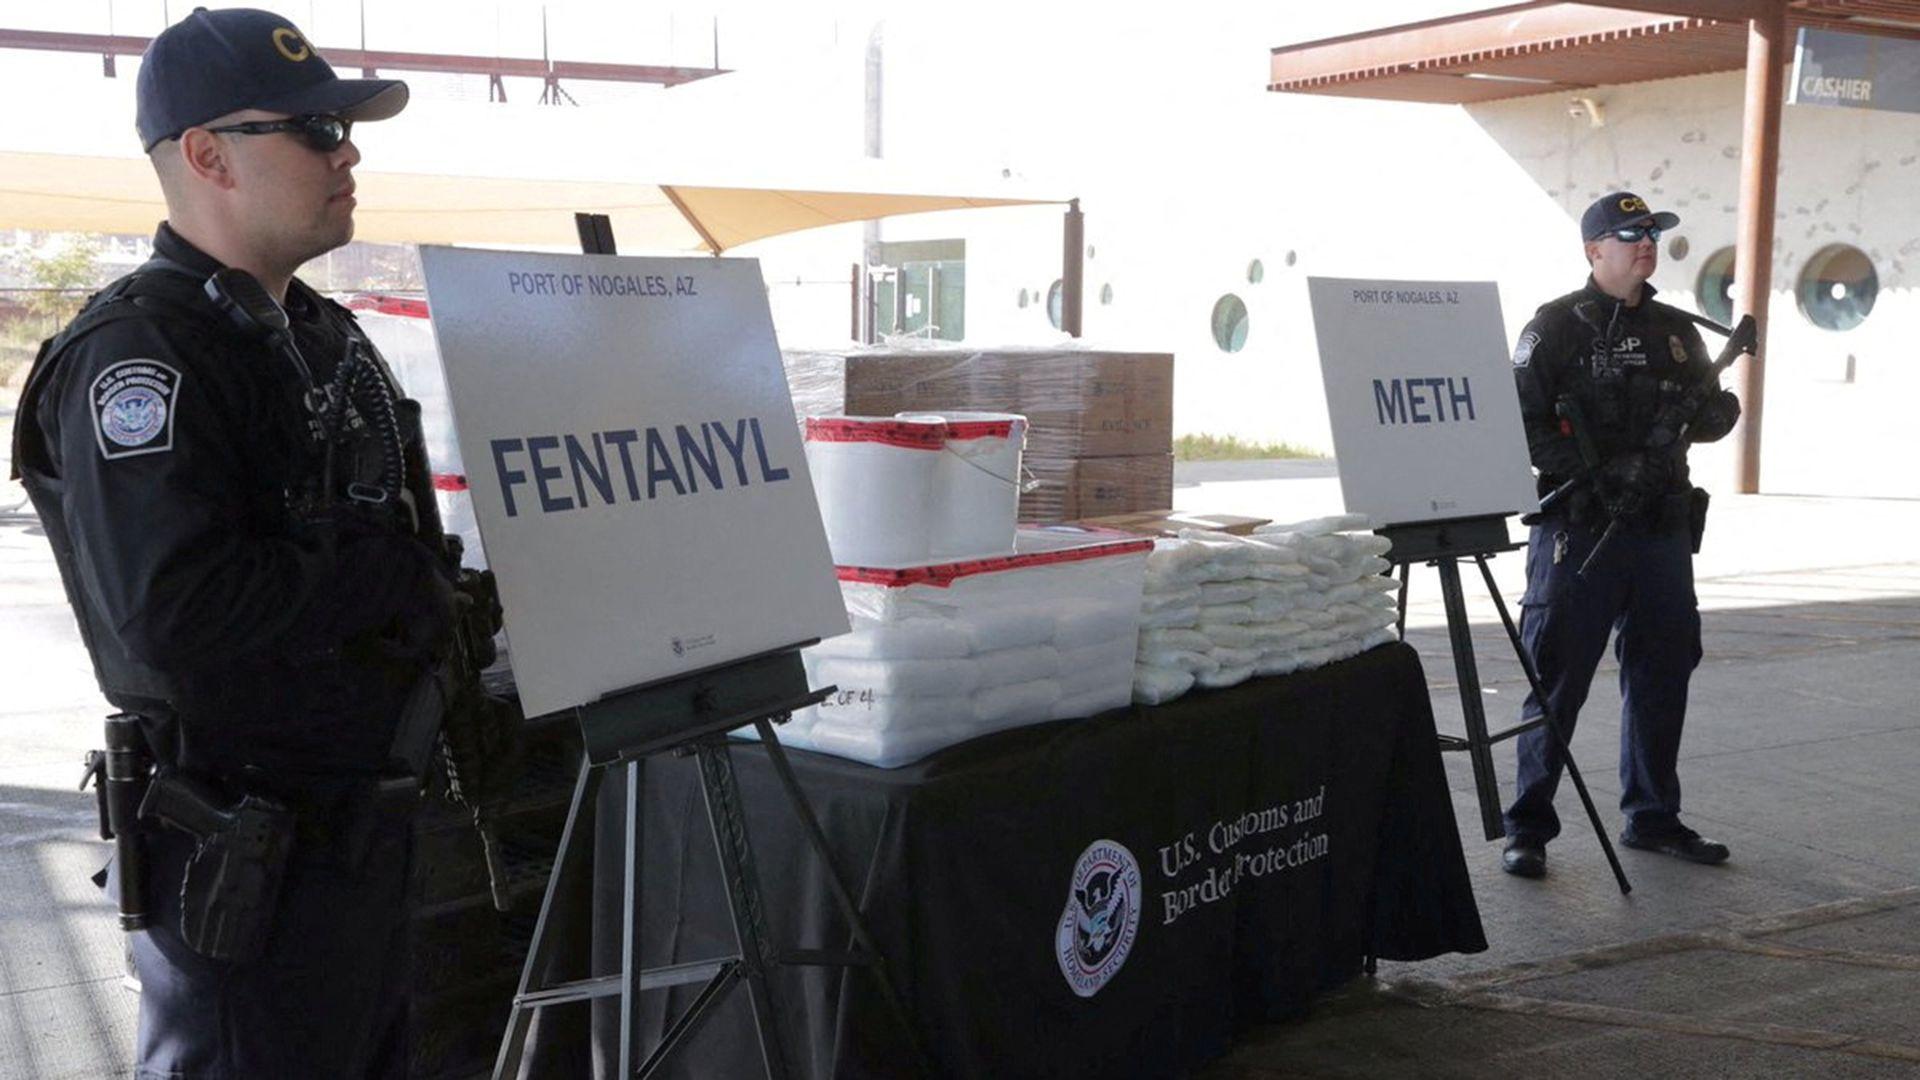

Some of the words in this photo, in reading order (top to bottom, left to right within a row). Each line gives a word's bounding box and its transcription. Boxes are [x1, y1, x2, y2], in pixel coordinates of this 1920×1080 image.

[1802, 77, 1872, 100] CASHIER
[508, 272, 556, 295] PORT
[561, 274, 583, 296] OF
[588, 275, 672, 297] NOGALES,
[675, 276, 697, 296] AZ
[1353, 290, 1379, 303] PORT
[1381, 290, 1394, 303] OF
[1446, 291, 1459, 304] AZ
[1373, 377, 1475, 425] METH
[490, 417, 790, 518] FENTANYL
[860, 687, 875, 711] 4
[1159, 832, 1202, 877] U.S.
[1208, 804, 1289, 854] Customs
[1294, 785, 1325, 824] and
[1075, 848, 1132, 888] DEPARTMENT
[1161, 867, 1232, 926] Border
[1233, 831, 1329, 885] Protection
